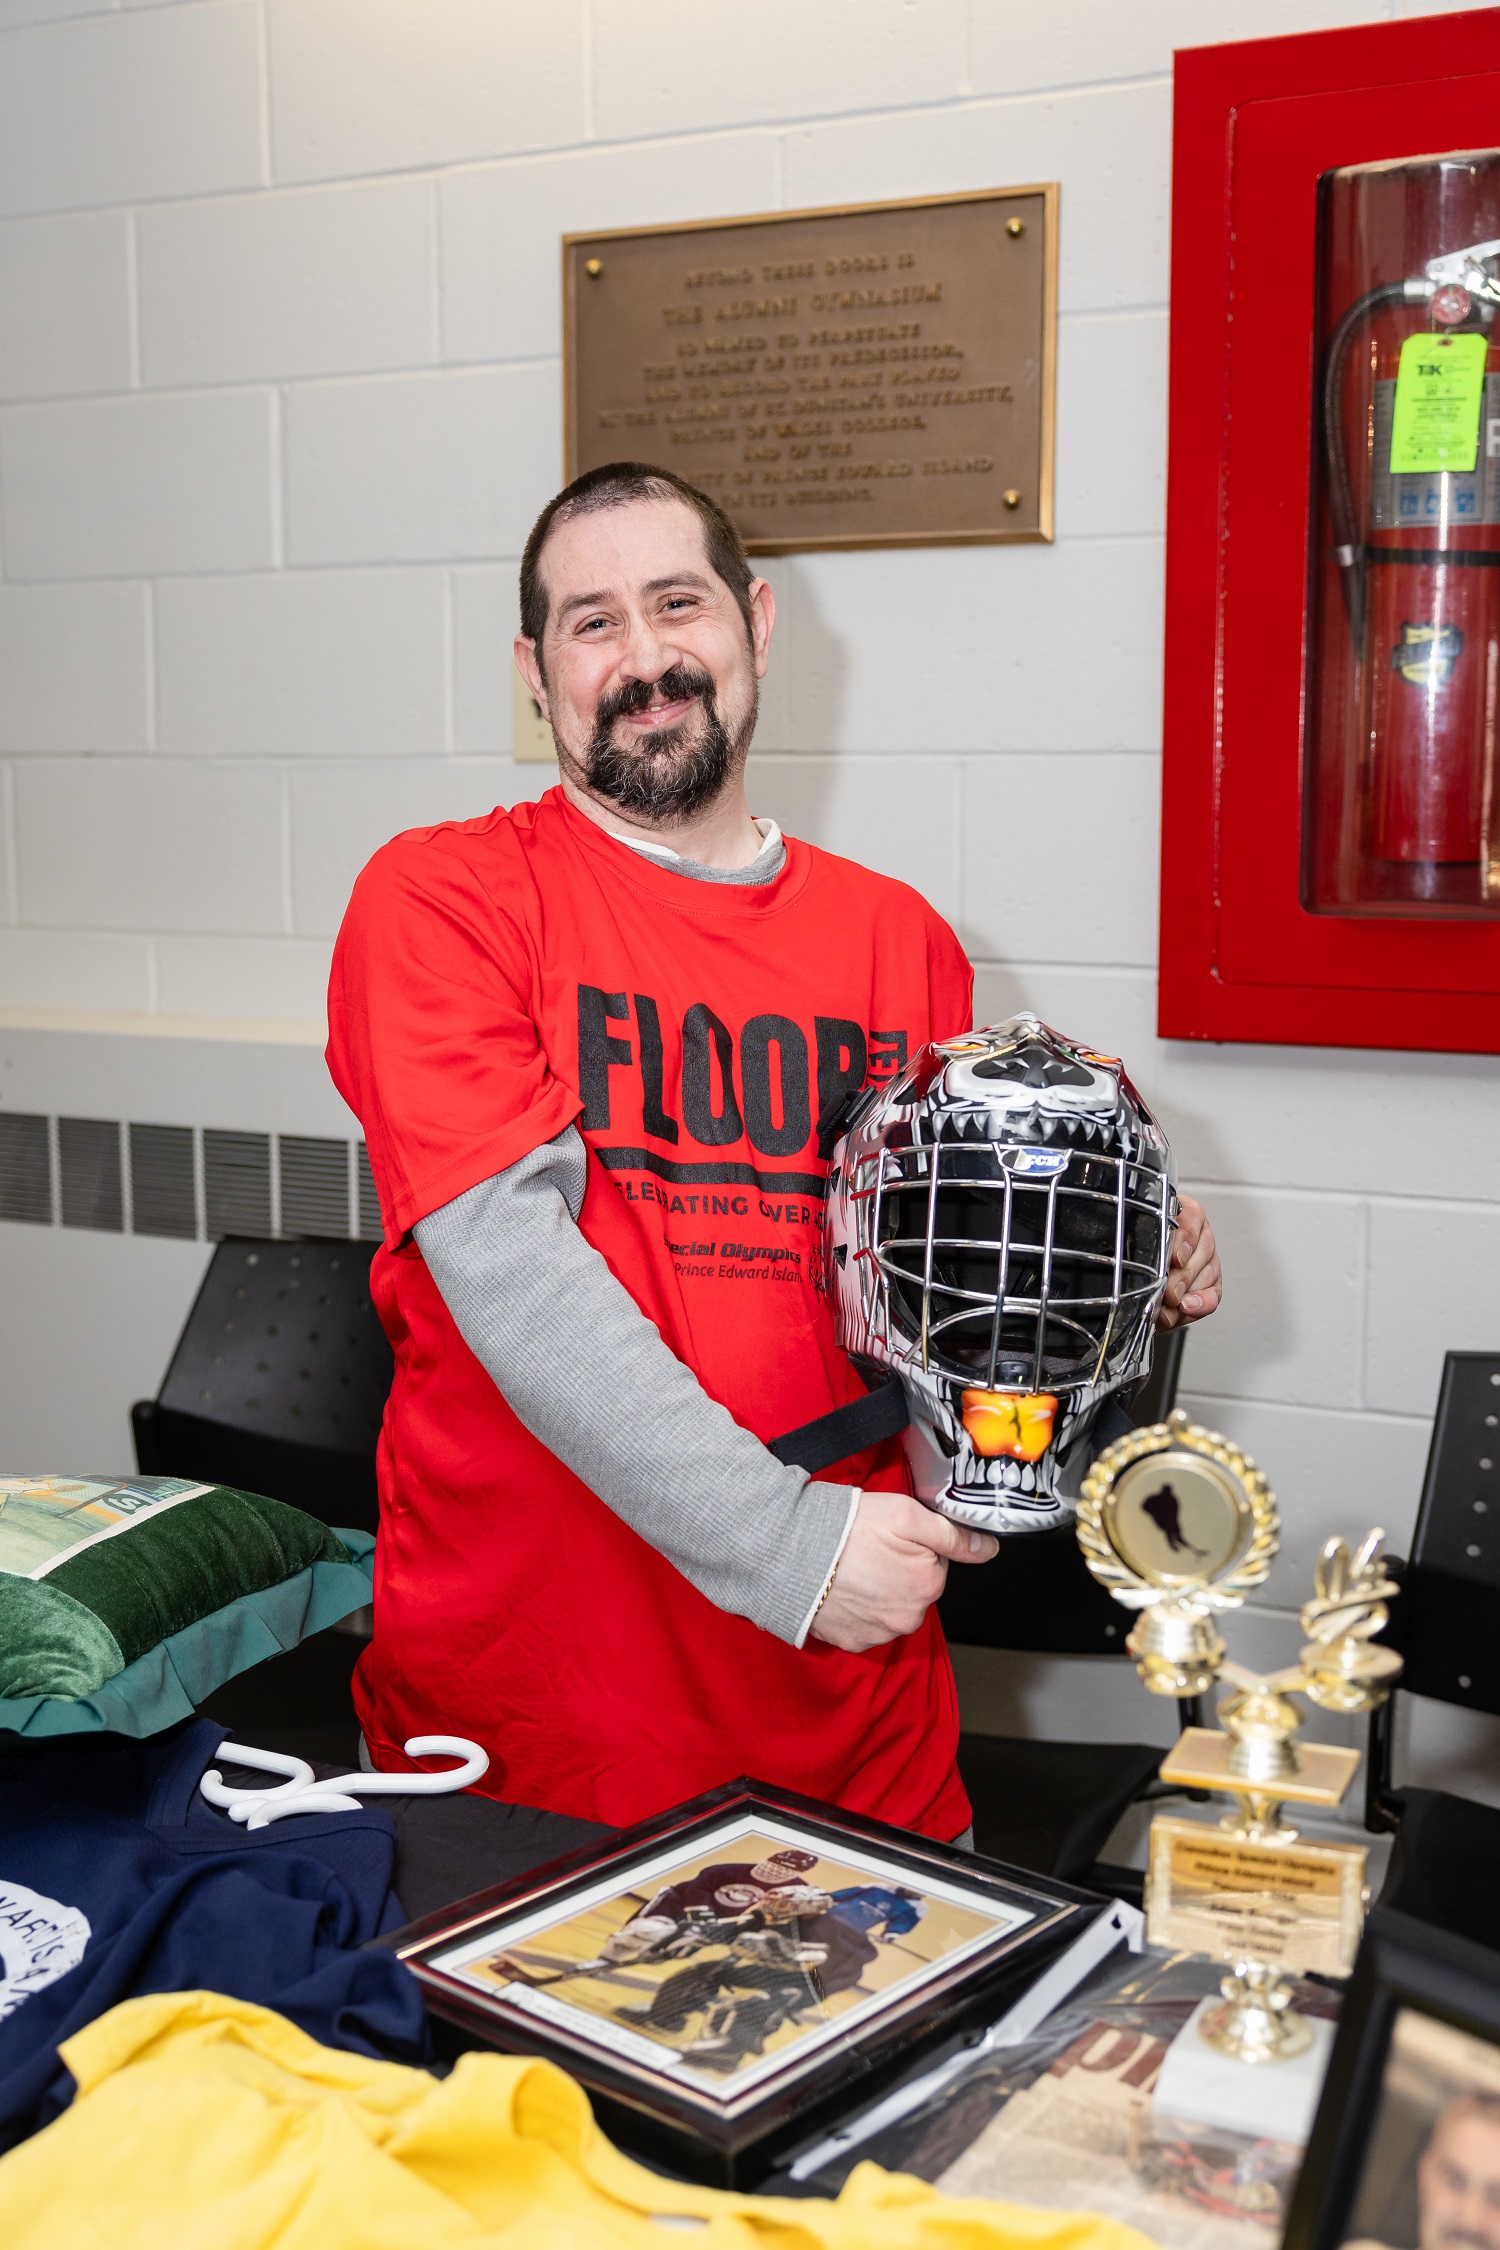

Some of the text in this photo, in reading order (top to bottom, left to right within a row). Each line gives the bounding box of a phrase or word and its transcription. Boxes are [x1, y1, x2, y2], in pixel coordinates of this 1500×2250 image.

[762, 261, 815, 281] THESE
[824, 255, 889, 277] DOORS
[897, 253, 915, 271] IS
[663, 282, 942, 326] THE ALUMNI GYMNASIUM
[704, 335, 768, 354] NAMED
[775, 333, 799, 350] TO
[809, 323, 921, 347] PERPETUATE
[644, 364, 676, 381] THE
[684, 356, 757, 378] MEMORY
[764, 354, 785, 372] OF
[793, 353, 820, 370] ITS
[645, 366, 960, 402] AND TO RECORD THE PART PLAYED
[624, 410, 656, 427] THE
[664, 403, 730, 424] ALUMNI
[736, 402, 758, 419] OF
[670, 426, 736, 445] PRINCE
[746, 424, 768, 440] OF
[773, 420, 833, 439] WALES
[743, 441, 852, 463] AND OF THE
[763, 466, 828, 484] PRINCE
[836, 459, 913, 481] EDWARD
[921, 455, 994, 477] ISLAND
[615, 1181, 748, 1215] LEBRATING
[759, 1200, 811, 1225] OVER
[720, 1243, 801, 1264] Olympics
[674, 1262, 802, 1284] Prince Edward Islan
